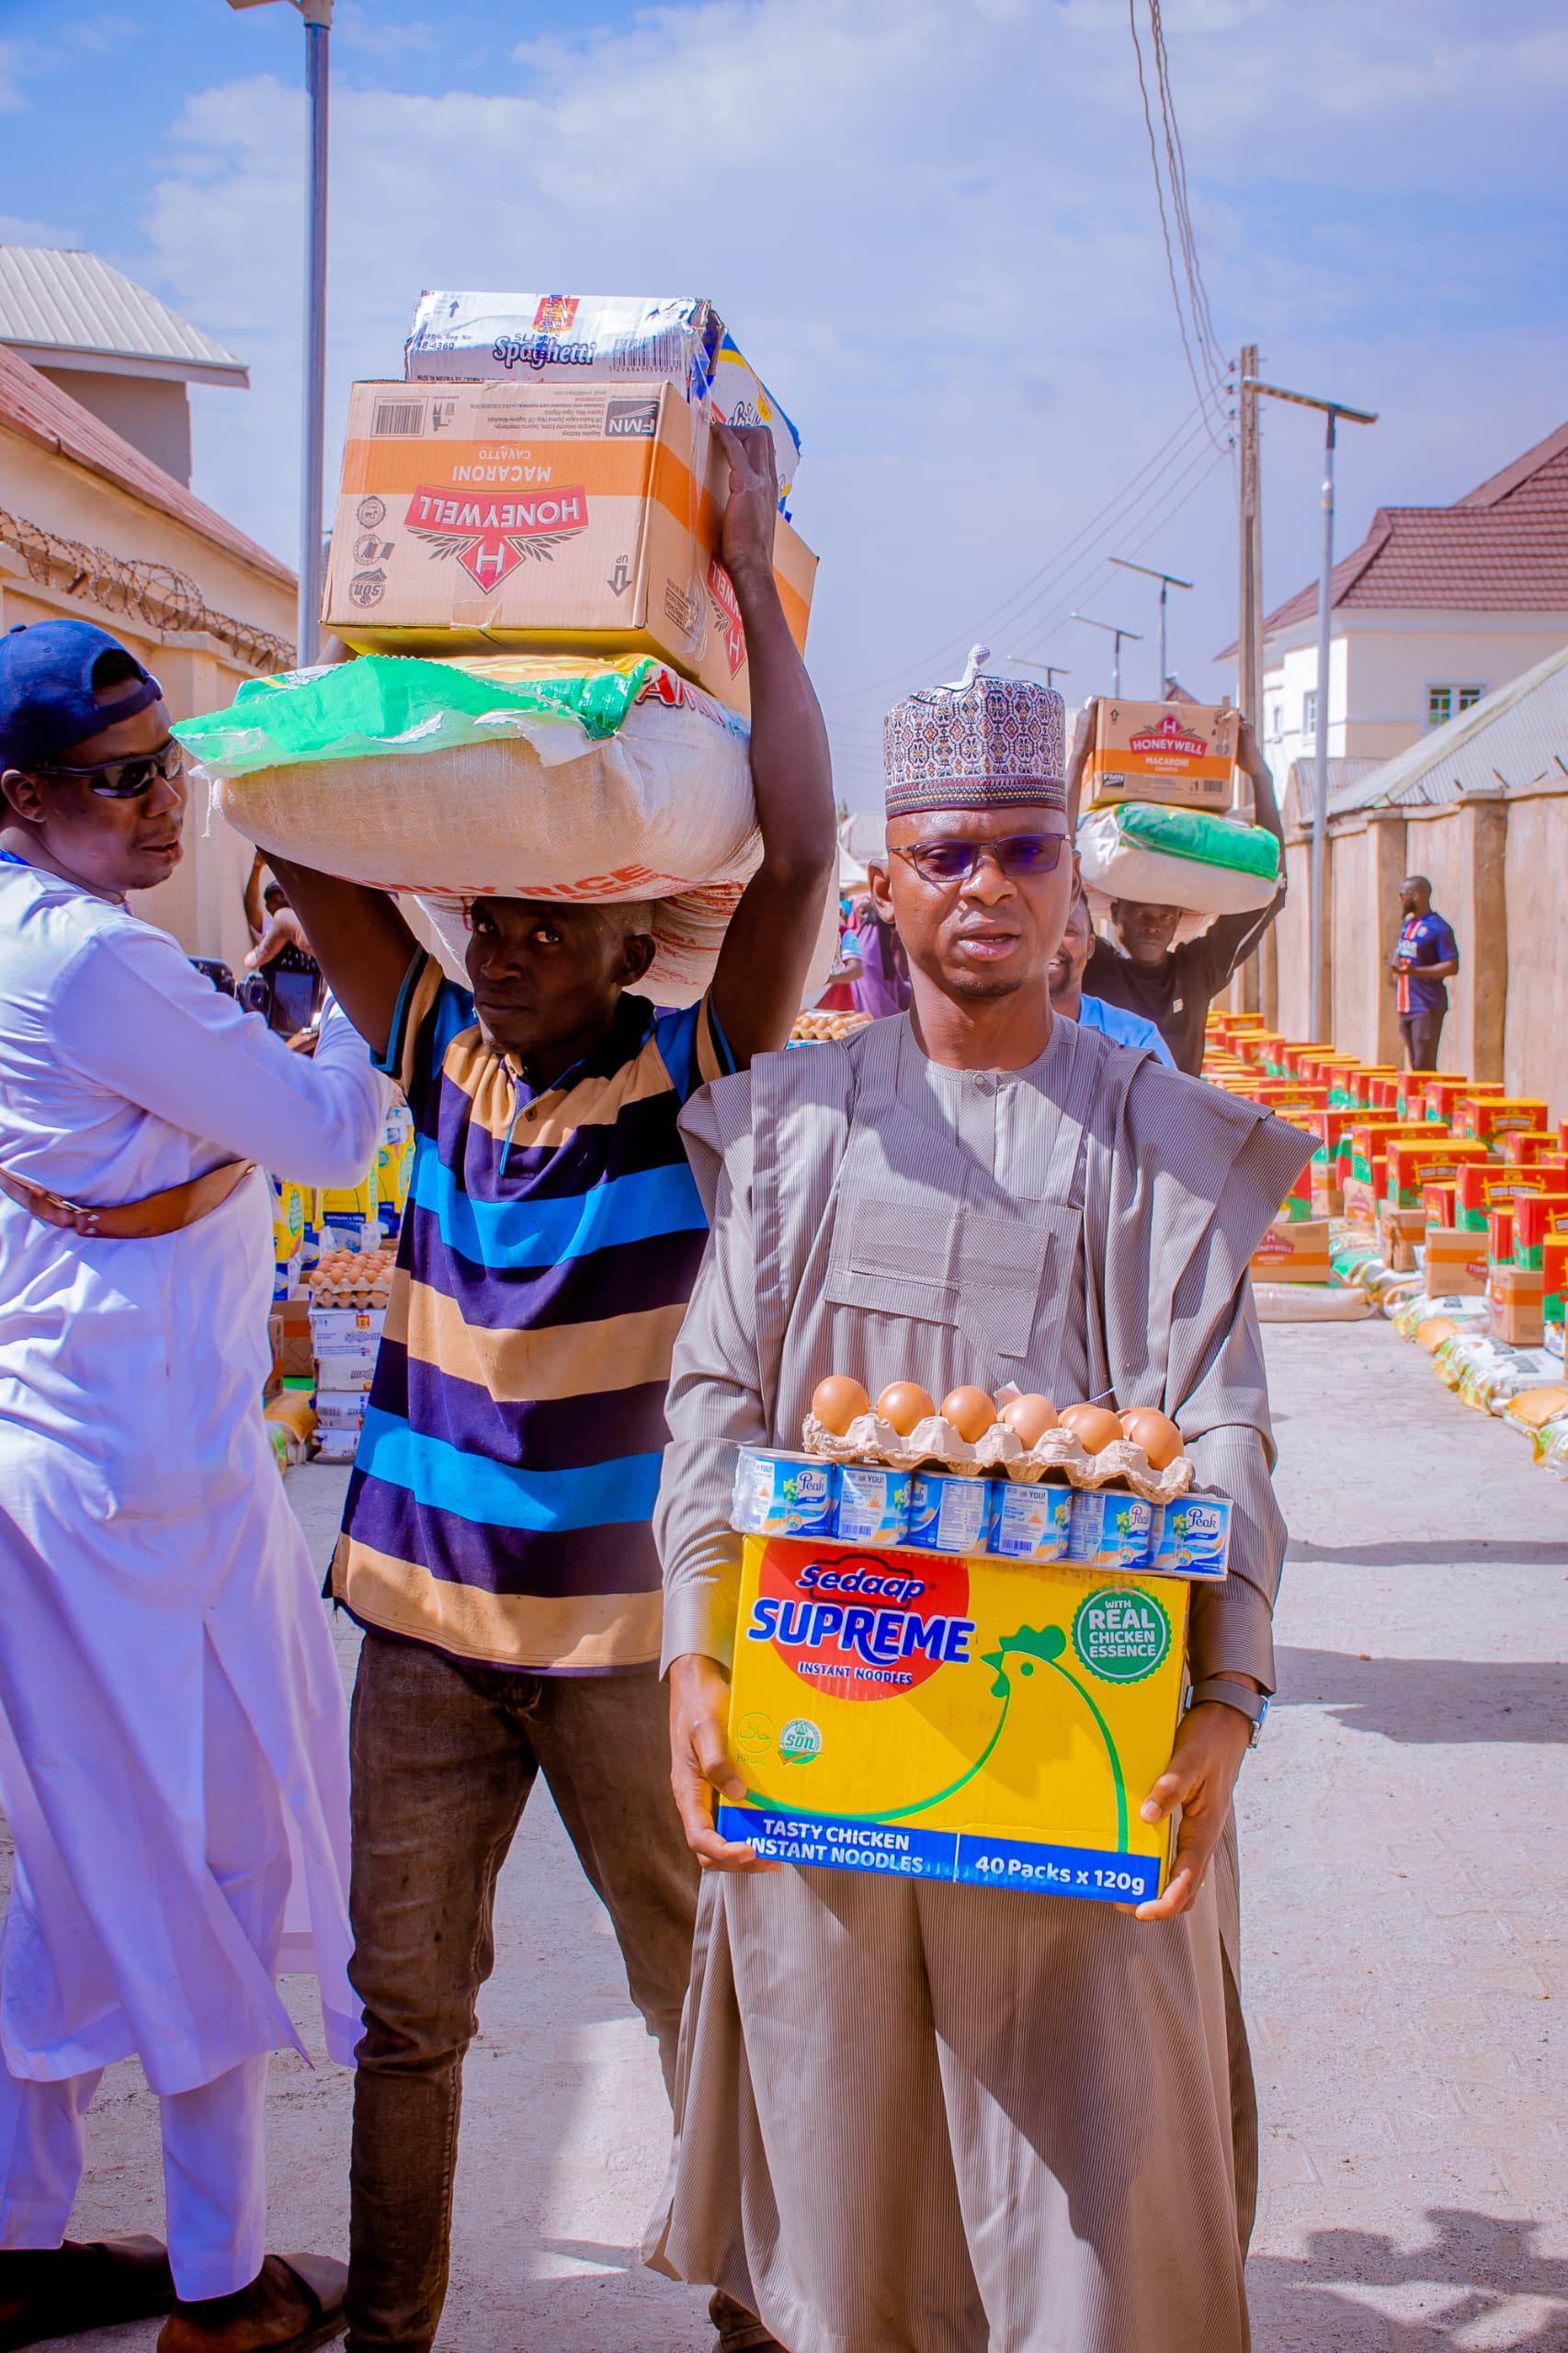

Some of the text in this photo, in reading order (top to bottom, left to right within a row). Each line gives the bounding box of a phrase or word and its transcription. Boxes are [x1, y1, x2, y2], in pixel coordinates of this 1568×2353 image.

[418, 341, 455, 350] 8-4360
[493, 335, 597, 370] Spaghetti
[609, 418, 655, 435] FMN
[478, 449, 531, 460] CAVATTO
[451, 465, 552, 483] MACARONI
[418, 495, 580, 528] HONEYWELL
[475, 541, 506, 577] H
[616, 554, 629, 564] UP
[729, 630, 739, 664] H
[1163, 721, 1176, 733] H
[1132, 739, 1202, 756] HONEYWELL
[1145, 756, 1189, 767] MACARONI
[515, 862, 653, 897] RICE
[798, 1472, 824, 1494] Peak
[867, 1472, 884, 1483] YOU!
[1028, 1490, 1046, 1500] YOU!
[1131, 1506, 1148, 1525] Pea
[1188, 1506, 1216, 1529] Peak
[796, 1564, 926, 1603] Sedaap
[1105, 1599, 1131, 1608] WITH
[1088, 1608, 1155, 1630] REAL
[746, 1597, 976, 1666] SUPREME
[1088, 1631, 1155, 1644] CHICKEN
[1089, 1644, 1156, 1658] ESSENCE
[798, 1662, 913, 1685] INSTANT NOODLES
[763, 1818, 910, 1851] TASTY CHICKEN
[745, 1836, 924, 1873] INSTANT NOODLES
[975, 1856, 1145, 1896] 40 Packs x 120g
